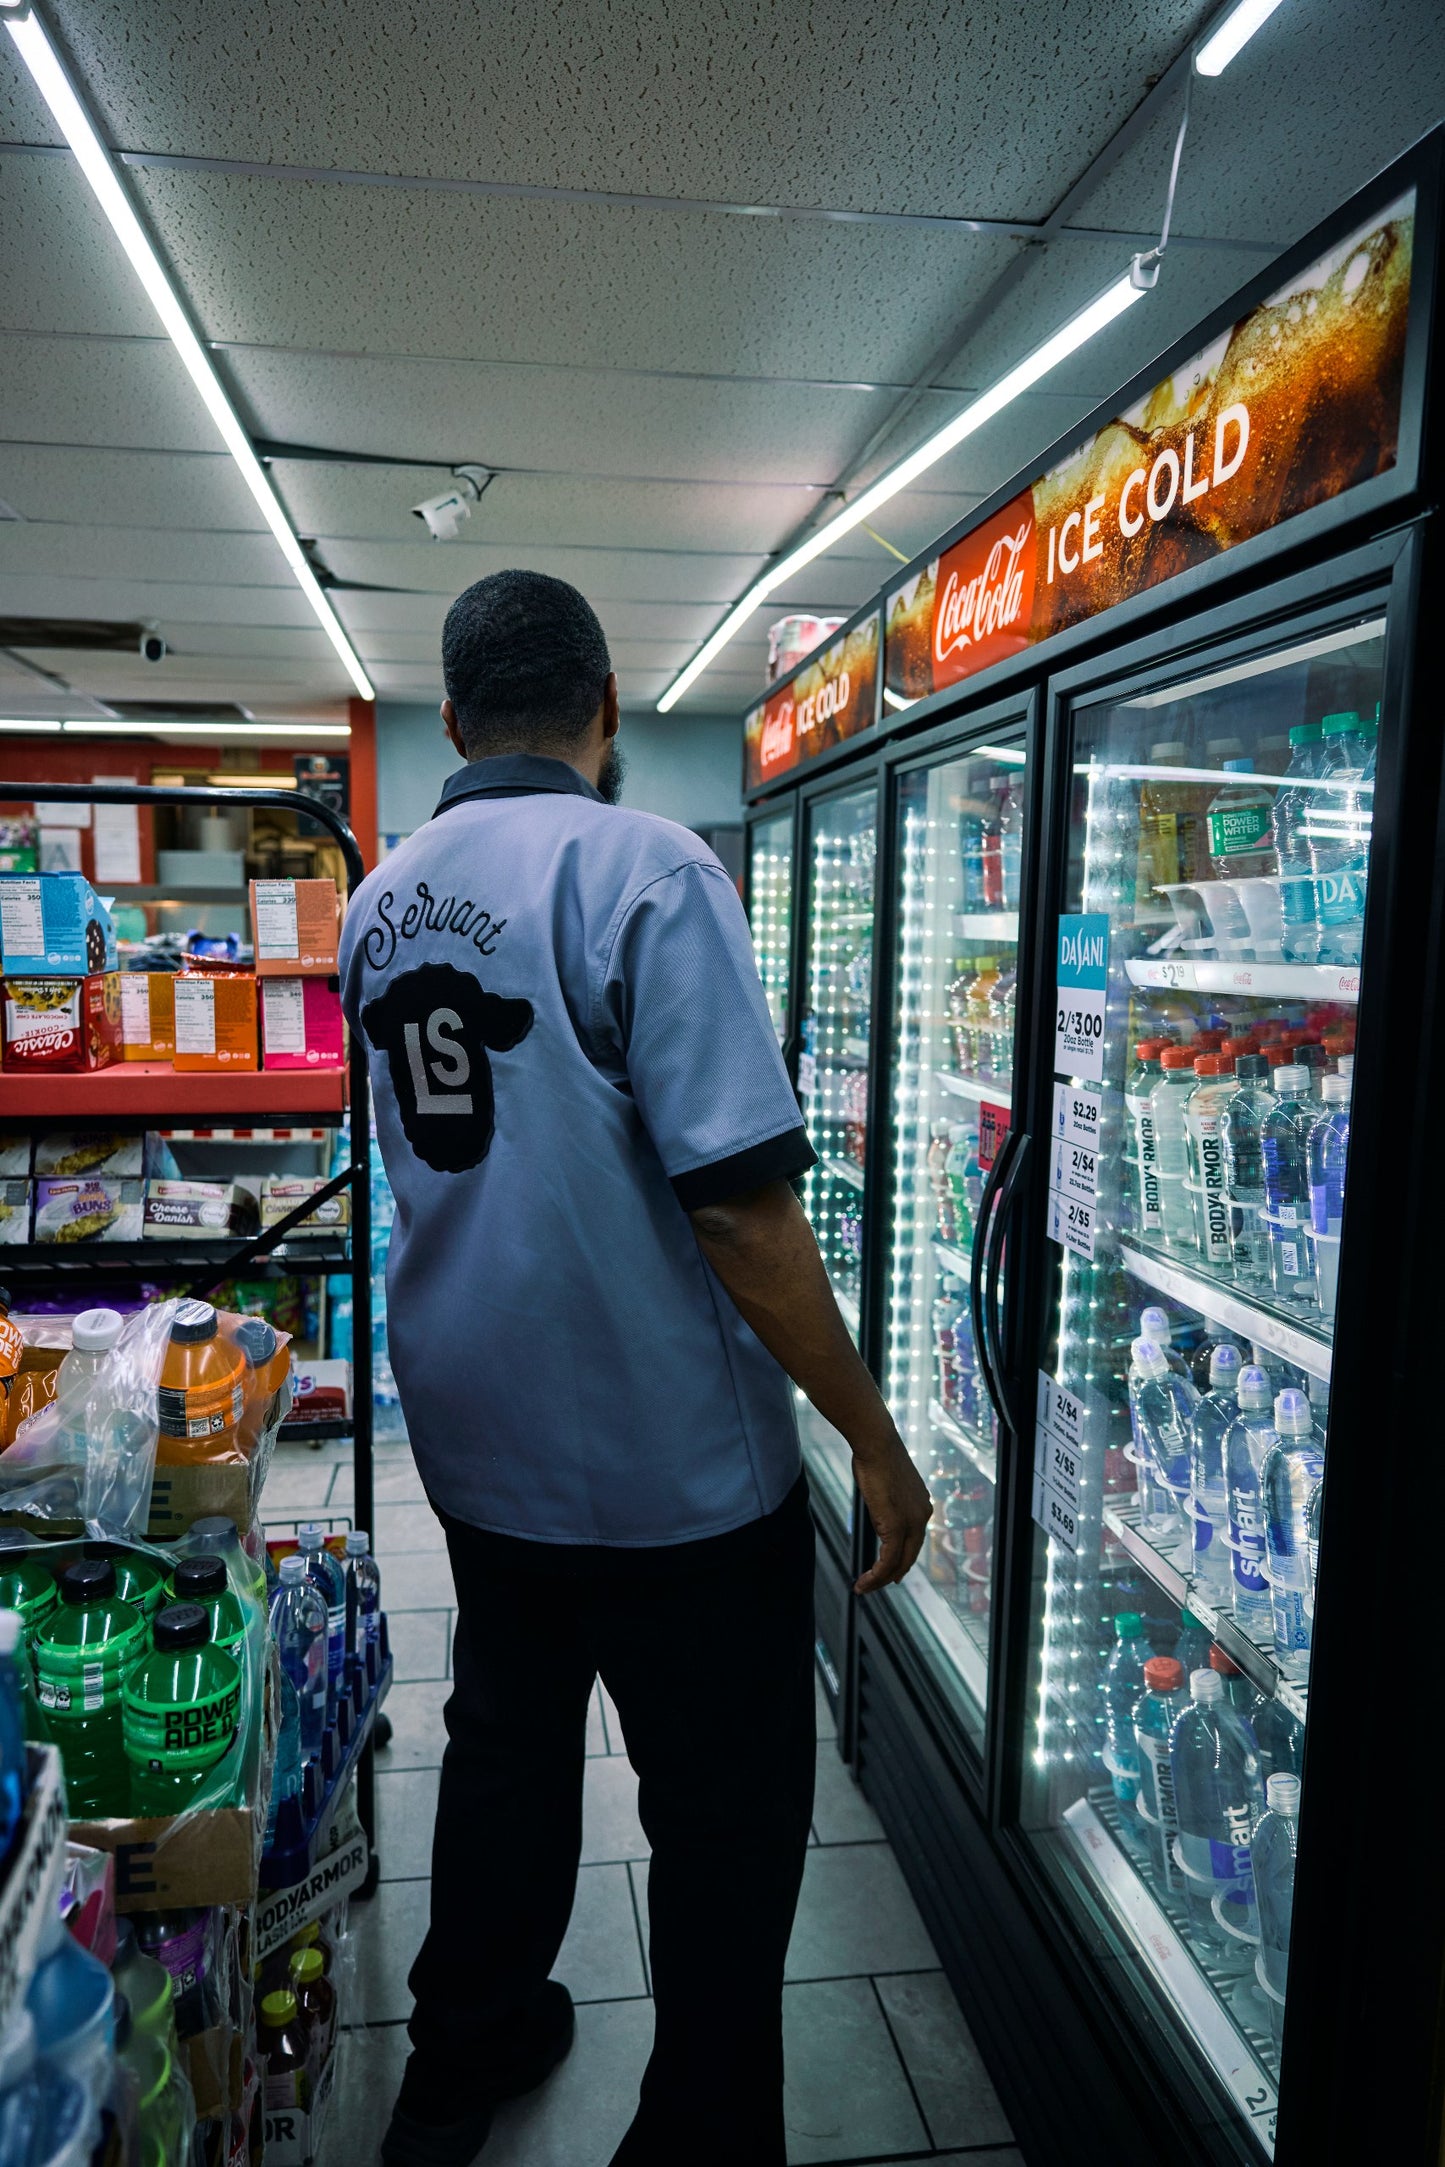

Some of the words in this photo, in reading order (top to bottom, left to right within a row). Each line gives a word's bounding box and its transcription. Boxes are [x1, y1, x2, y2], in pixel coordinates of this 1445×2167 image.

[1047, 493, 1106, 586] ICE
[1118, 402, 1250, 539] COLD
[935, 518, 1033, 662] Coca-Cola
[796, 695, 816, 738] ICE
[815, 671, 850, 724] COLD
[1223, 815, 1259, 827] POWER
[1223, 824, 1260, 836] WATER
[363, 881, 508, 971] Servant
[1061, 927, 1104, 976] DASANI
[24, 1025, 60, 1038] COOKIE
[1057, 1010, 1102, 1039] 2/$3.00
[13, 1030, 74, 1057] Classic
[1077, 1036, 1094, 1048] Bottle
[403, 1007, 473, 1115] LS
[1073, 1100, 1097, 1122] $2.29
[1072, 1150, 1095, 1174] 2/$4
[72, 1199, 113, 1215] BUNS
[149, 1202, 190, 1215] Cheese
[153, 1212, 195, 1224] Danish
[1068, 1205, 1090, 1228] 2/$5
[1057, 1394, 1078, 1422] 2/$4
[1055, 1448, 1075, 1477] 2/$5
[1051, 1501, 1075, 1534] $3.69
[1231, 1486, 1265, 1579] smart
